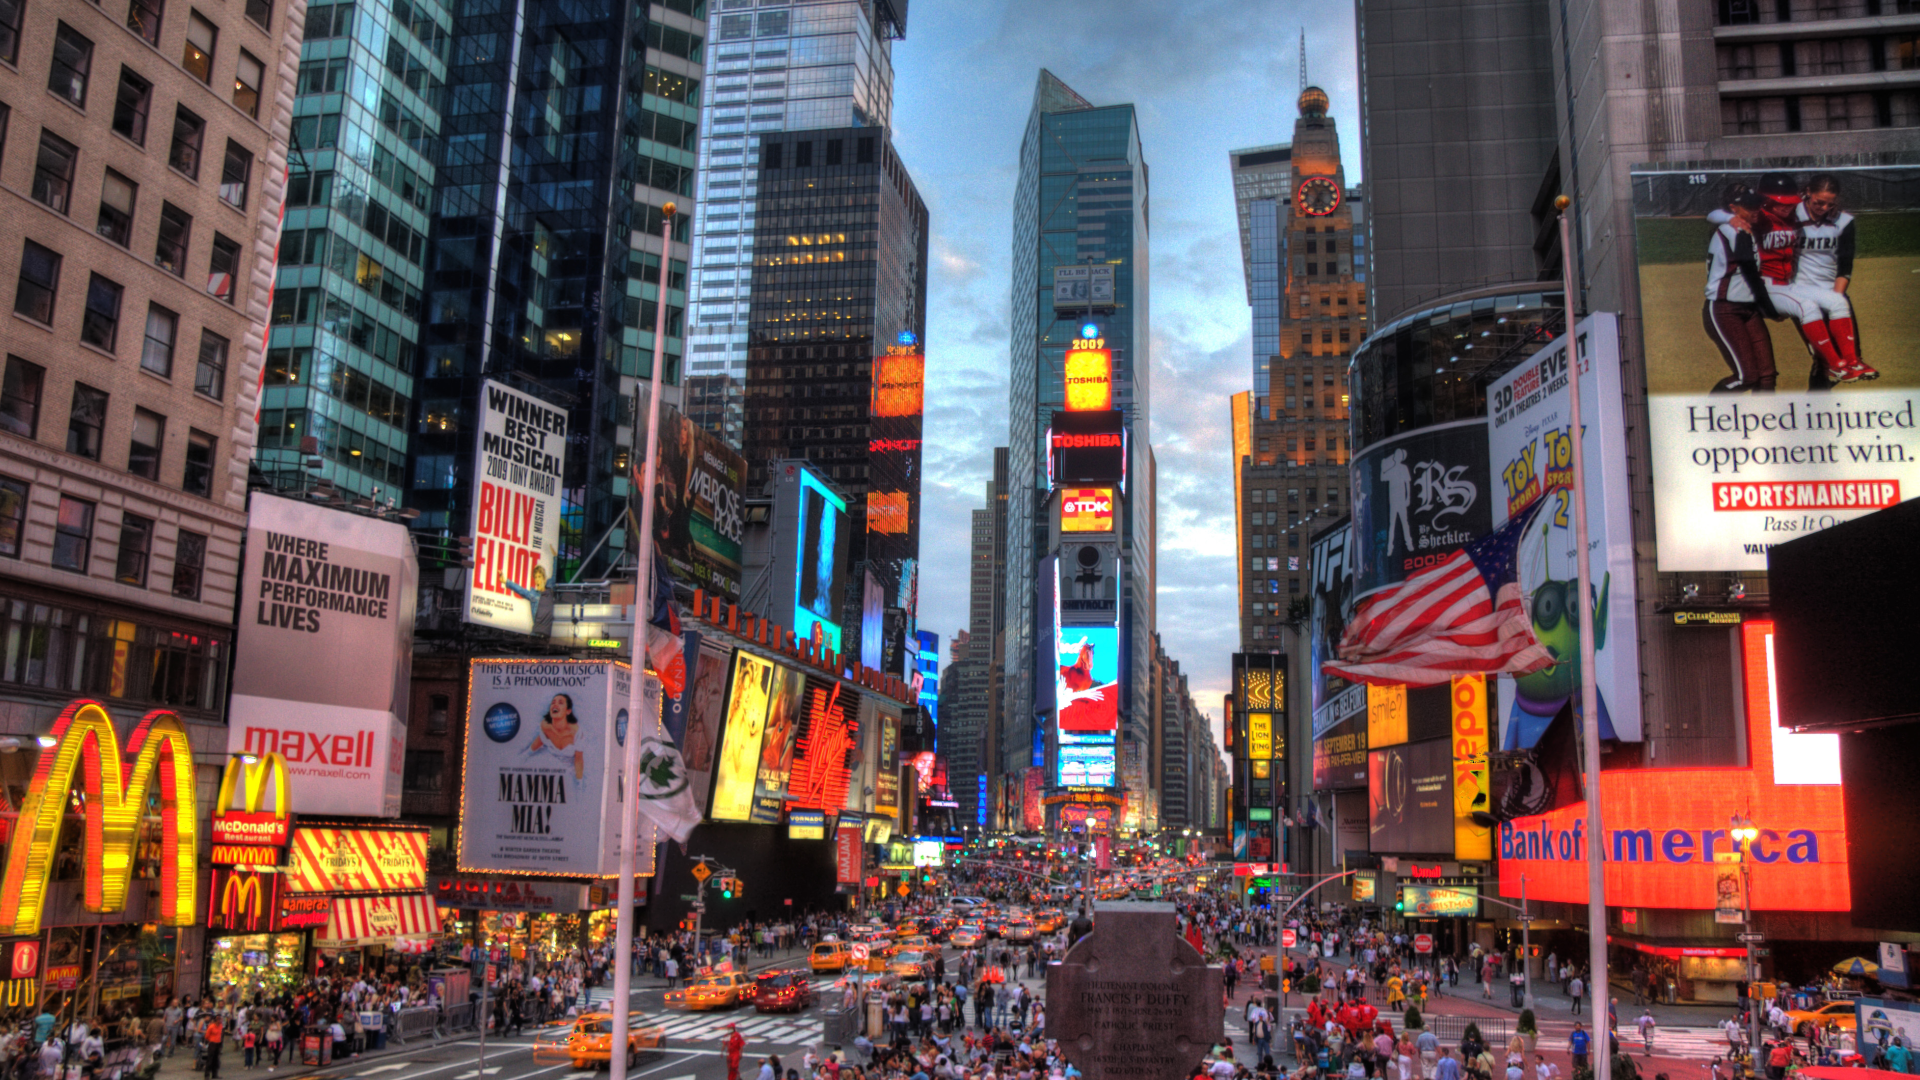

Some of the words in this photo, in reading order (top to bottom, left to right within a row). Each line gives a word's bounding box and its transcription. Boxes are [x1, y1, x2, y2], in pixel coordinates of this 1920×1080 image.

[1688, 174, 1707, 184] 215
[1072, 339, 1105, 350] 2009
[1067, 376, 1109, 385] TOSHIBA
[1494, 384, 1513, 414] 3D
[1513, 364, 1539, 389] DOUBLE
[1514, 377, 1540, 402] FEATURE
[488, 386, 566, 438] WINNER
[1508, 408, 1515, 420] IN
[1516, 391, 1541, 417] THEATRES
[1542, 387, 1547, 399] 2
[505, 416, 548, 444] BEST
[1686, 402, 1799, 440] Helped
[1805, 399, 1916, 438] injured
[1053, 434, 1121, 448] TOSHIBA
[483, 431, 562, 478] MUSICAL
[1692, 442, 1839, 473] opponent
[1846, 435, 1915, 463] win.
[487, 455, 507, 481] 2009
[509, 462, 528, 489] TONY
[529, 466, 555, 497] AWARD
[1502, 436, 1538, 500] TOY
[688, 467, 740, 520] MELROSE
[1413, 458, 1477, 531] RS
[1510, 481, 1538, 517] STORY
[1718, 482, 1895, 508] SPORTSMANSHIP
[478, 481, 535, 548] BILLY
[534, 500, 546, 534] MUSICAL
[1074, 501, 1109, 513] TDK
[1553, 487, 1570, 530] 2
[713, 505, 743, 546] PLACE
[1763, 515, 1797, 532] Pass
[1801, 515, 1816, 531] It
[266, 531, 329, 560] WHERE
[532, 533, 543, 549] THE
[1418, 531, 1470, 549] Sheckler
[473, 536, 541, 600] ELLIOT
[1403, 552, 1447, 570] 2009
[262, 551, 390, 599] MAXIMUM
[260, 581, 388, 619] PERFORMANCE
[1062, 601, 1115, 611] CHEVROLET
[257, 601, 320, 633] LIVES
[493, 676, 502, 686] IS
[504, 676, 511, 686] A
[506, 664, 560, 675] FEEL-GOOD
[563, 665, 606, 676] MUSICAL
[1372, 693, 1403, 724] smile?
[244, 726, 374, 768] maxell
[1252, 731, 1269, 742] LION
[1252, 743, 1270, 753] KING
[1323, 733, 1356, 755] SEPTEMBER
[1357, 731, 1366, 750] 19
[1331, 750, 1367, 768] PAY-PER-VIEW
[288, 766, 371, 780] ww.maxell.com
[498, 773, 566, 804] MAMMA
[214, 820, 285, 835] McDonald's
[510, 804, 552, 834] MIA!
[224, 833, 271, 843] Restaurant
[1501, 820, 1555, 860] Bank
[1558, 818, 1583, 861] of
[326, 858, 357, 867] FRIDAY'S
[383, 858, 411, 867] FRIDAY'S
[840, 834, 851, 881] JAMJAM
[439, 880, 536, 896] DIGITAL
[1403, 878, 1478, 886] MARQUIS
[1428, 889, 1460, 899] WHITE
[1417, 896, 1473, 914] CHRISTMAS
[1081, 992, 1131, 1005] FRANCIS
[1147, 994, 1190, 1006] DUFFY
[1087, 982, 1138, 991] LIEUTENANT
[1140, 982, 1181, 992] COLONEL
[1094, 1021, 1137, 1030] CATHOLIC
[1142, 1022, 1174, 1031] PRIEST
[1113, 1043, 1156, 1052] CHAPLAIN
